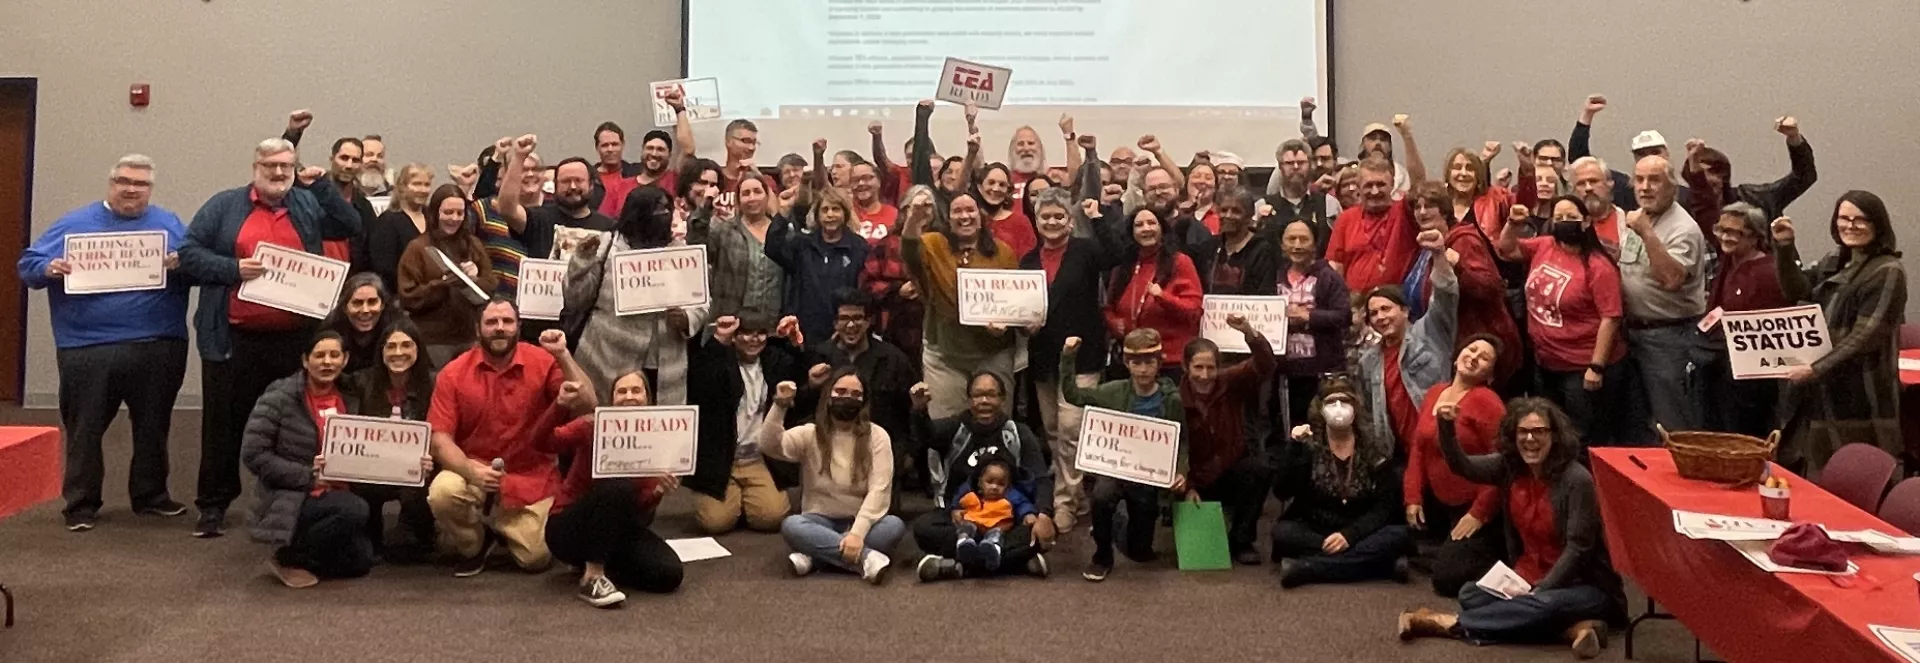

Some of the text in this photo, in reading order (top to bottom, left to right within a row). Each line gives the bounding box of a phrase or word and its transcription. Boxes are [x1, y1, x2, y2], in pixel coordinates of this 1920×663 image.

[953, 66, 993, 92] TEA
[70, 240, 146, 251] BUILDING A
[69, 248, 161, 261] STRIKE READY
[75, 260, 111, 271] NION
[260, 252, 339, 282] I'M READY
[618, 256, 699, 276] I'M READY
[525, 268, 548, 282] I'M
[964, 278, 1039, 291] I'M READY
[1205, 302, 1260, 312] BUILDING
[1727, 314, 1816, 333] MAJORITY
[1733, 330, 1823, 351] STATUS
[602, 417, 691, 433] I'M READY
[1089, 418, 1172, 445] I'M READY
[331, 425, 421, 446] I'M READY
